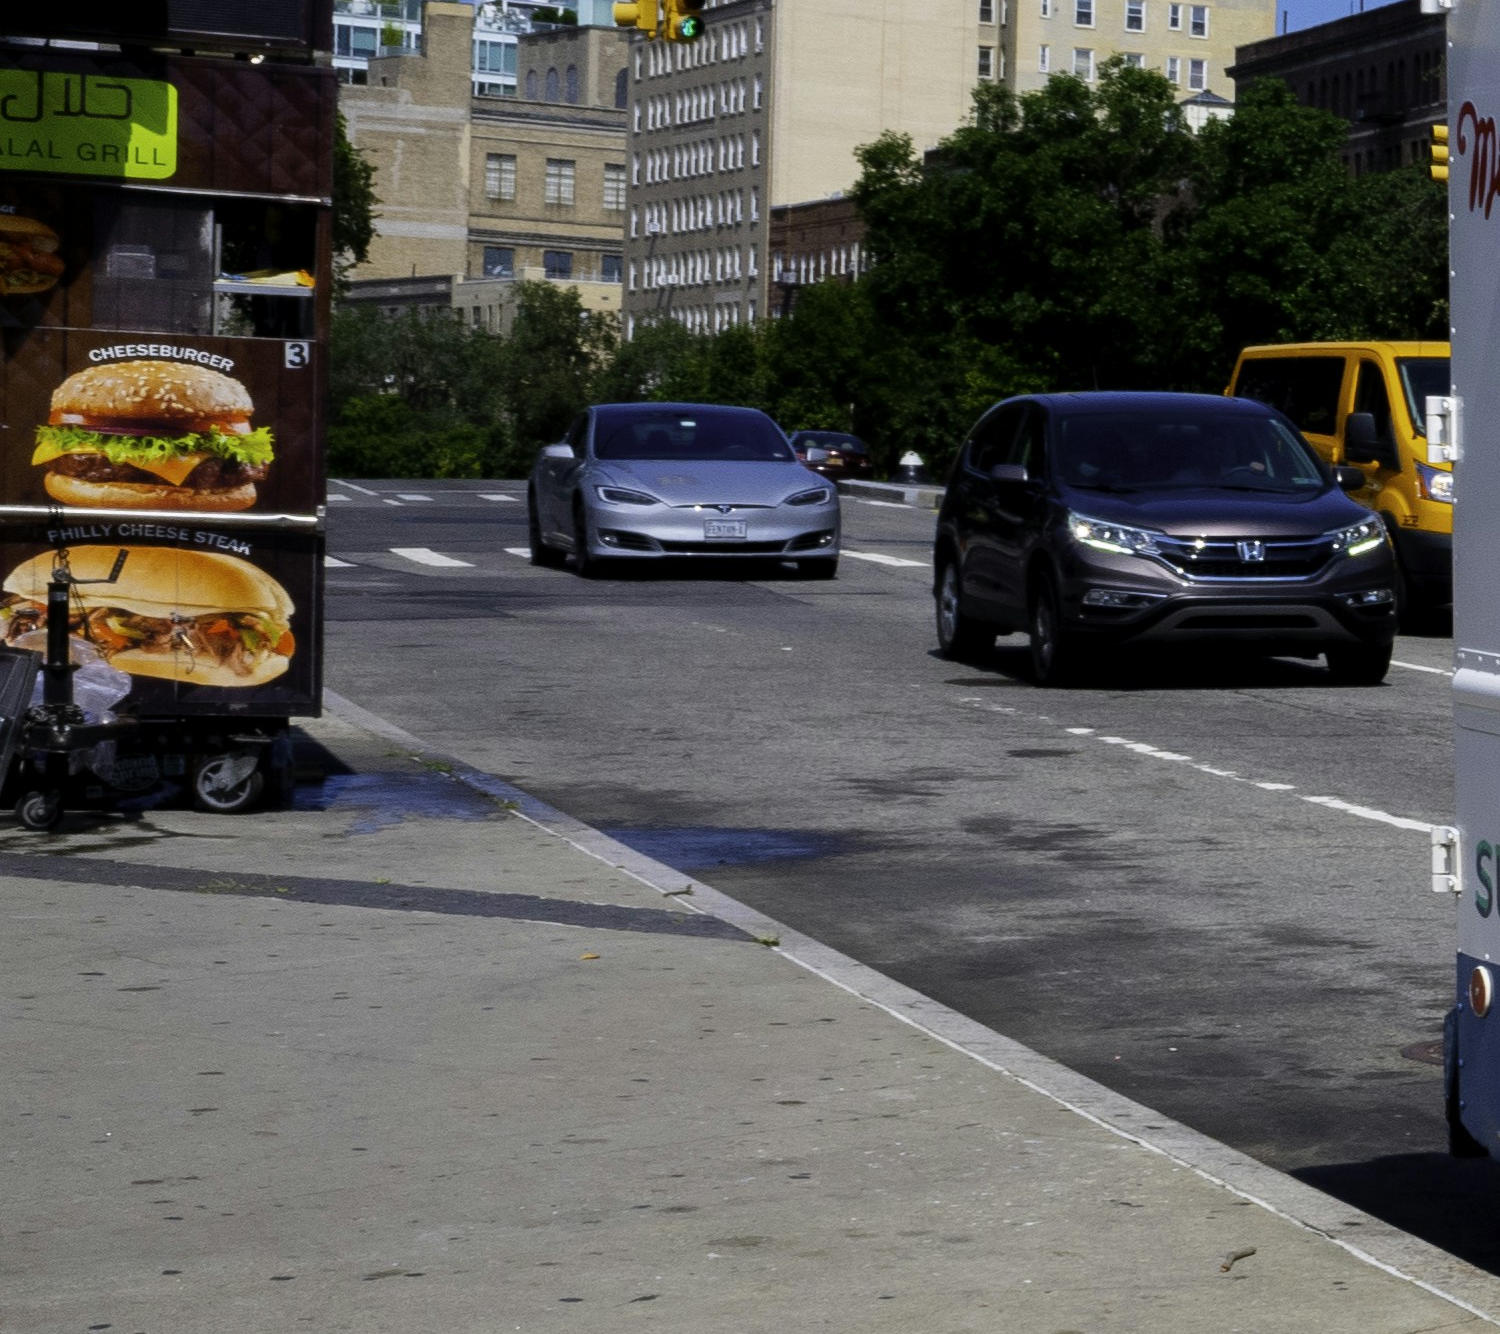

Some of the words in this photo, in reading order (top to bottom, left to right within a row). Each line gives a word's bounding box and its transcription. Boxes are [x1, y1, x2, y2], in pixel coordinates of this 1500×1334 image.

[76, 142, 166, 166] GRILL
[89, 344, 235, 372] CHEESEBURGER
[288, 343, 306, 367] 3
[48, 524, 114, 543] PHILLY
[118, 523, 189, 541] CHEESE
[194, 531, 253, 556] STEAK
